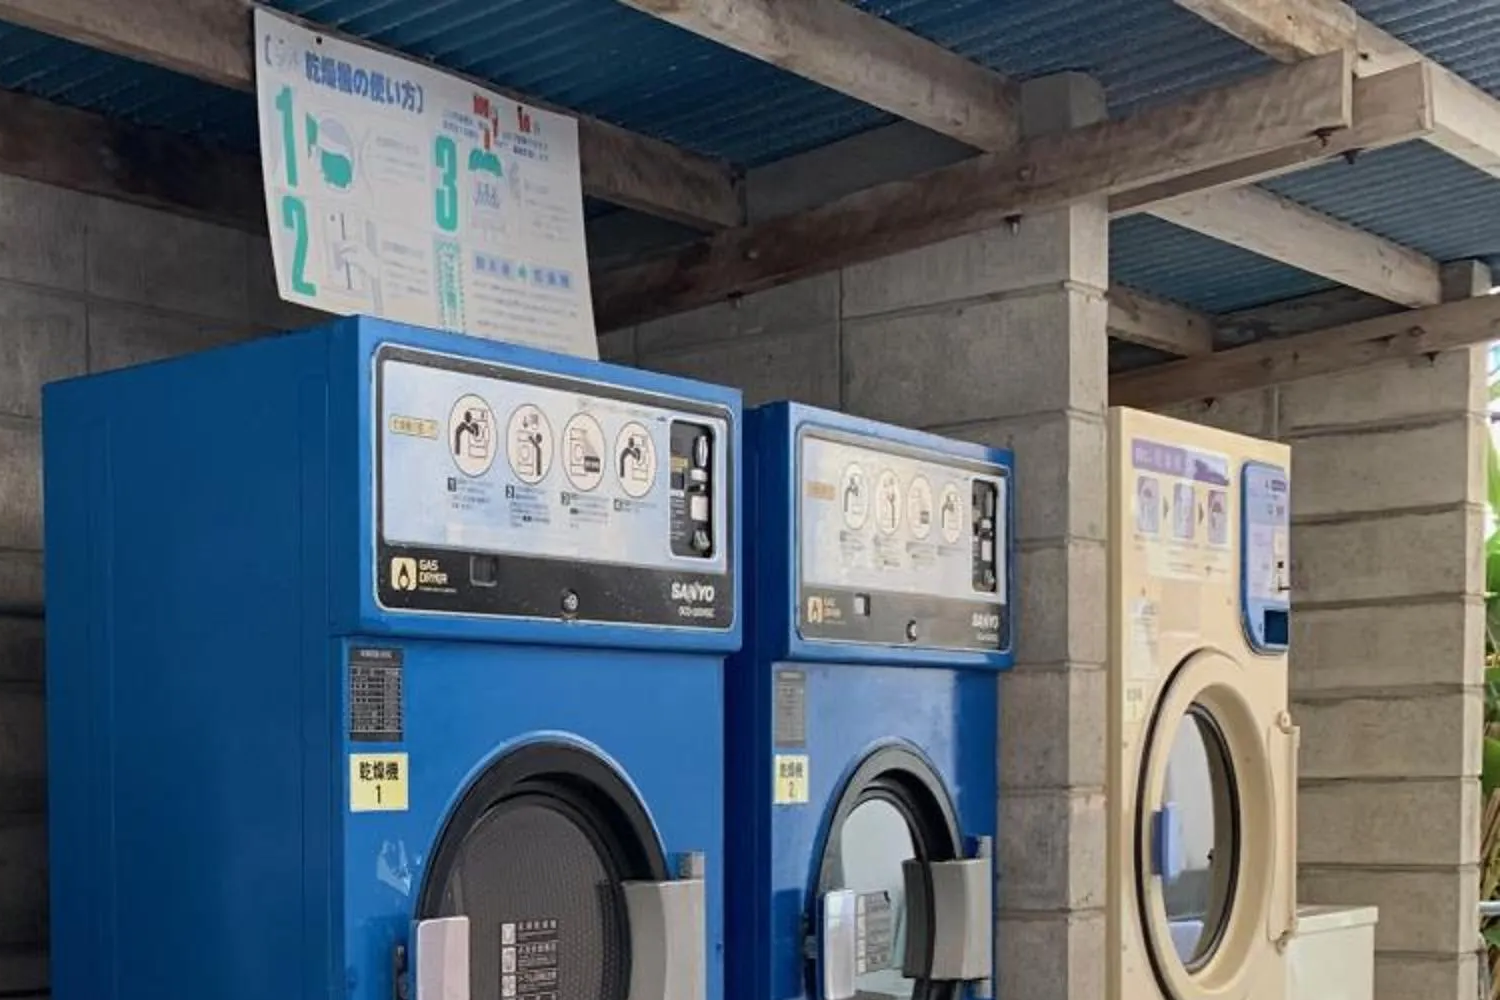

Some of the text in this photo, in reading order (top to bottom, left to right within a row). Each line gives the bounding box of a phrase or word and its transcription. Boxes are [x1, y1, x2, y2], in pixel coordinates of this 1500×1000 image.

[276, 86, 298, 189] 1
[436, 135, 458, 232] 3
[282, 195, 316, 296] 2
[419, 559, 439, 571] GAS
[671, 582, 715, 603] SANYO
[359, 761, 399, 781] 乾燥機
[375, 785, 381, 804] 1
